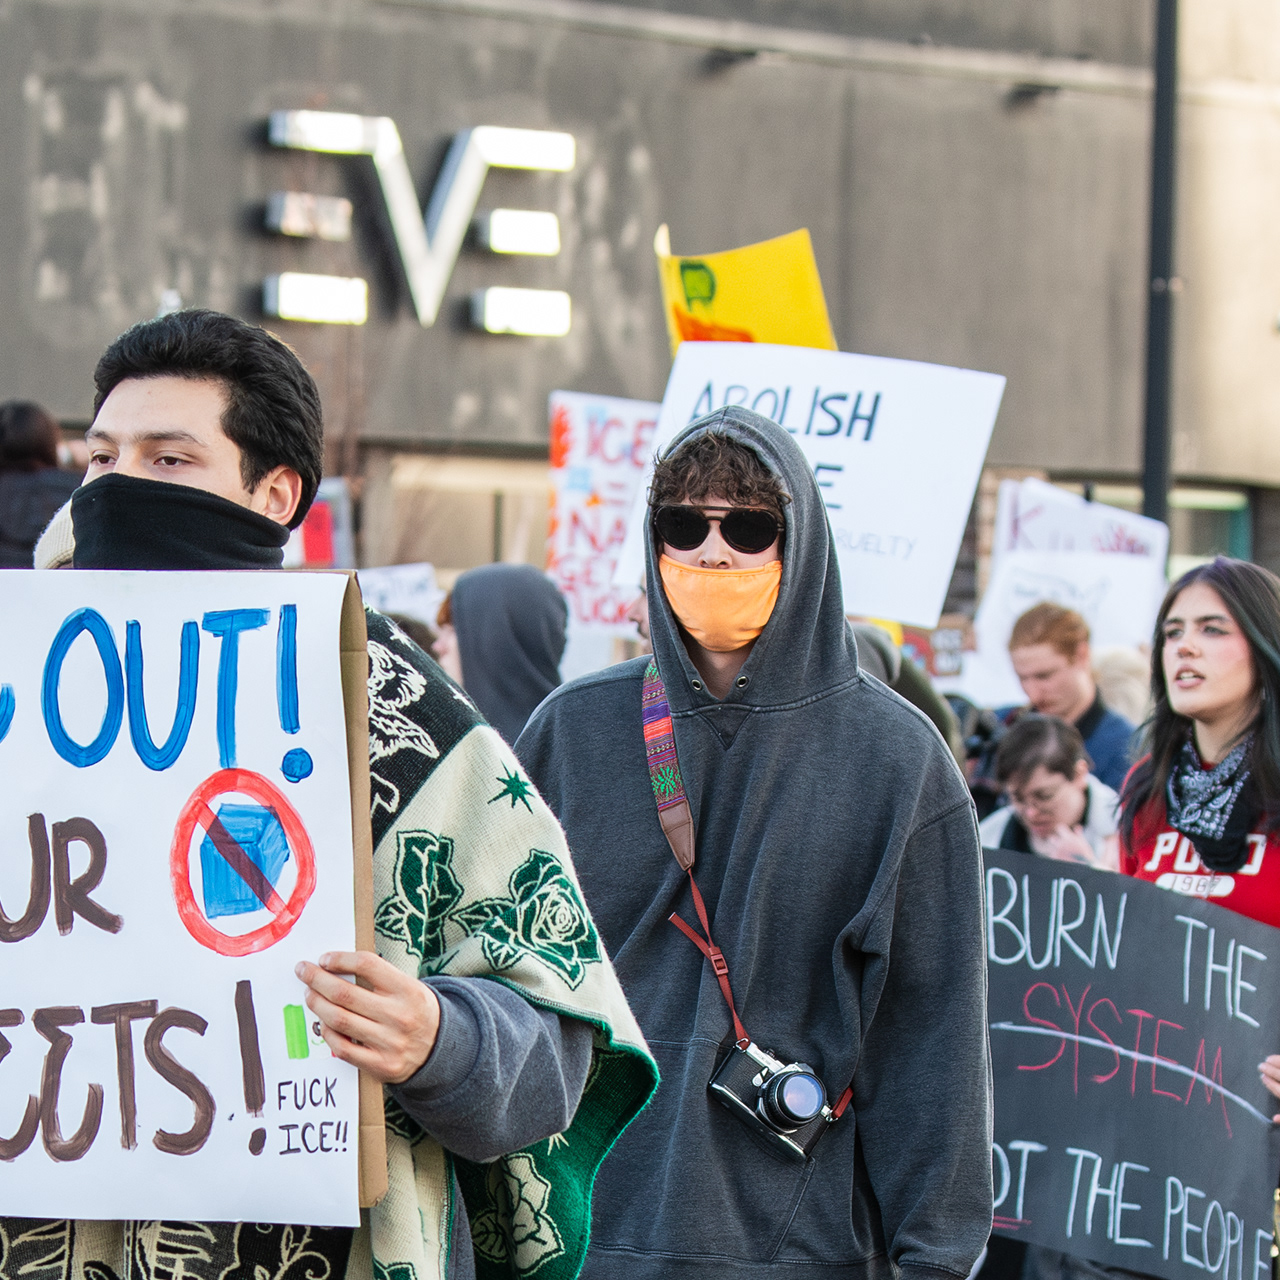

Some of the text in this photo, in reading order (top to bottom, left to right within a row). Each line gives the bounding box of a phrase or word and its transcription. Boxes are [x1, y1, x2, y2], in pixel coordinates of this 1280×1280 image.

[41, 602, 314, 783] OUT!
[986, 866, 1268, 1028] BURN THE
[277, 1076, 338, 1111] FUCK
[1017, 981, 1233, 1139] SYSTEM
[278, 1120, 349, 1156] ICE!!
[1065, 1146, 1153, 1249] THE
